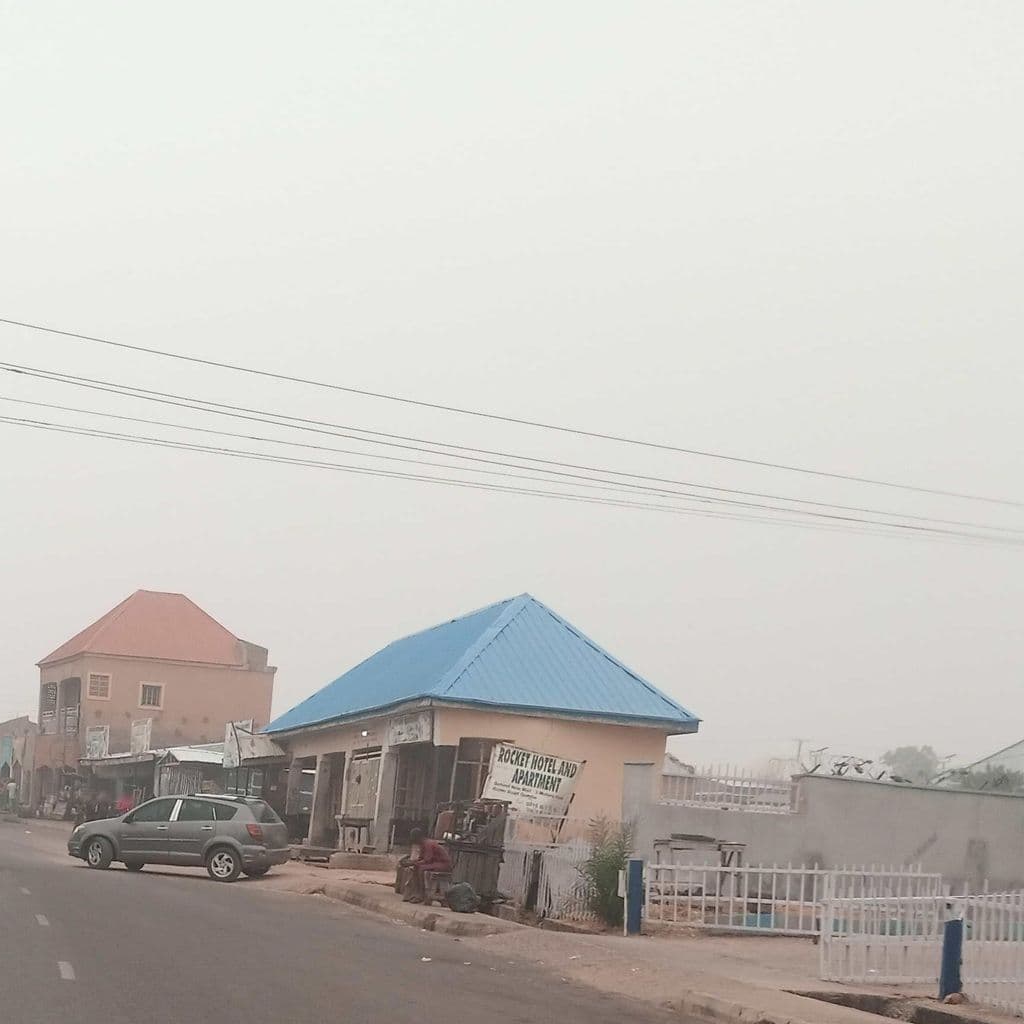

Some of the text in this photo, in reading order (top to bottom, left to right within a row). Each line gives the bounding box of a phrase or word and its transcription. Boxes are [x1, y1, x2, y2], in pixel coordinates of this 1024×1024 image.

[498, 747, 578, 778] ROCKET HOTEL AND
[511, 768, 562, 793] APARTMENT
